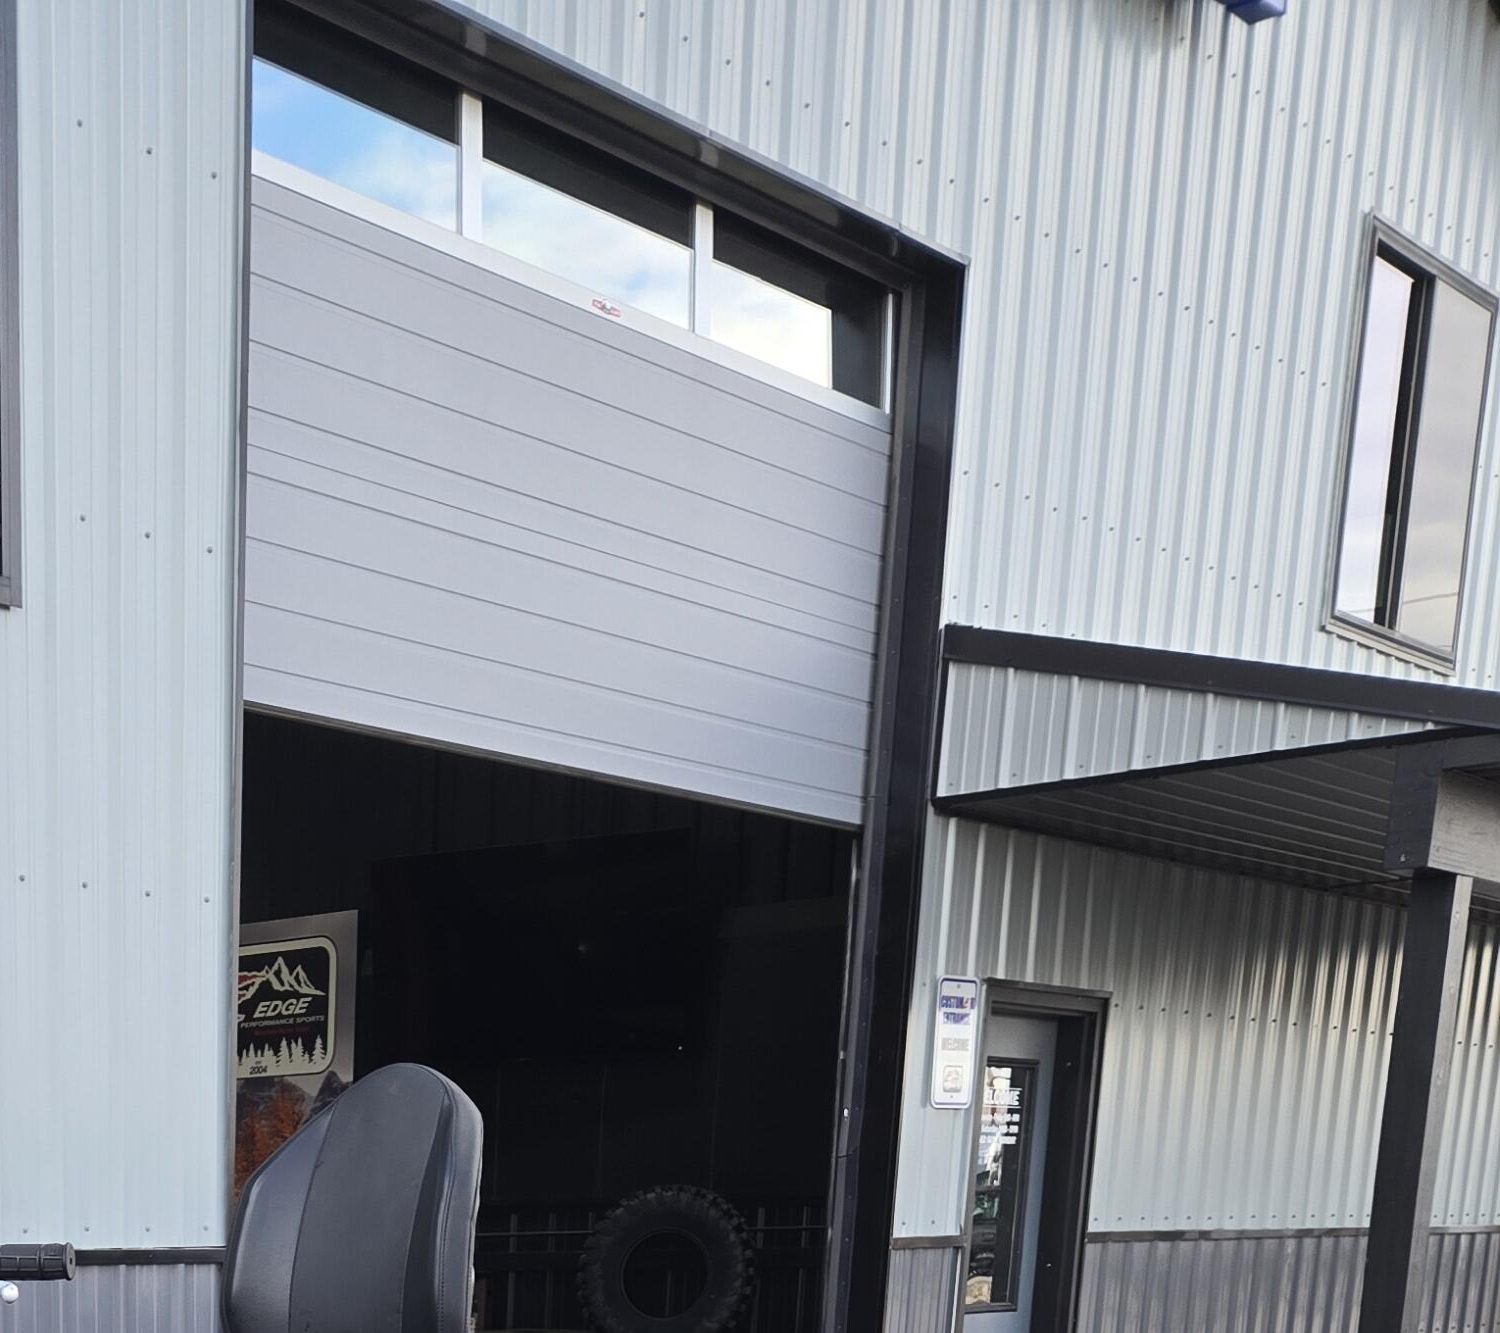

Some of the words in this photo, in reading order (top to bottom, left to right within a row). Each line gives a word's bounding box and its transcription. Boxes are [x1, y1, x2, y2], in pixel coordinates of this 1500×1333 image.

[253, 997, 313, 1018] EDGE
[240, 1019, 294, 1028] PERFORMANCE
[296, 1014, 325, 1024] SPORTS
[249, 1065, 268, 1075] 2004
